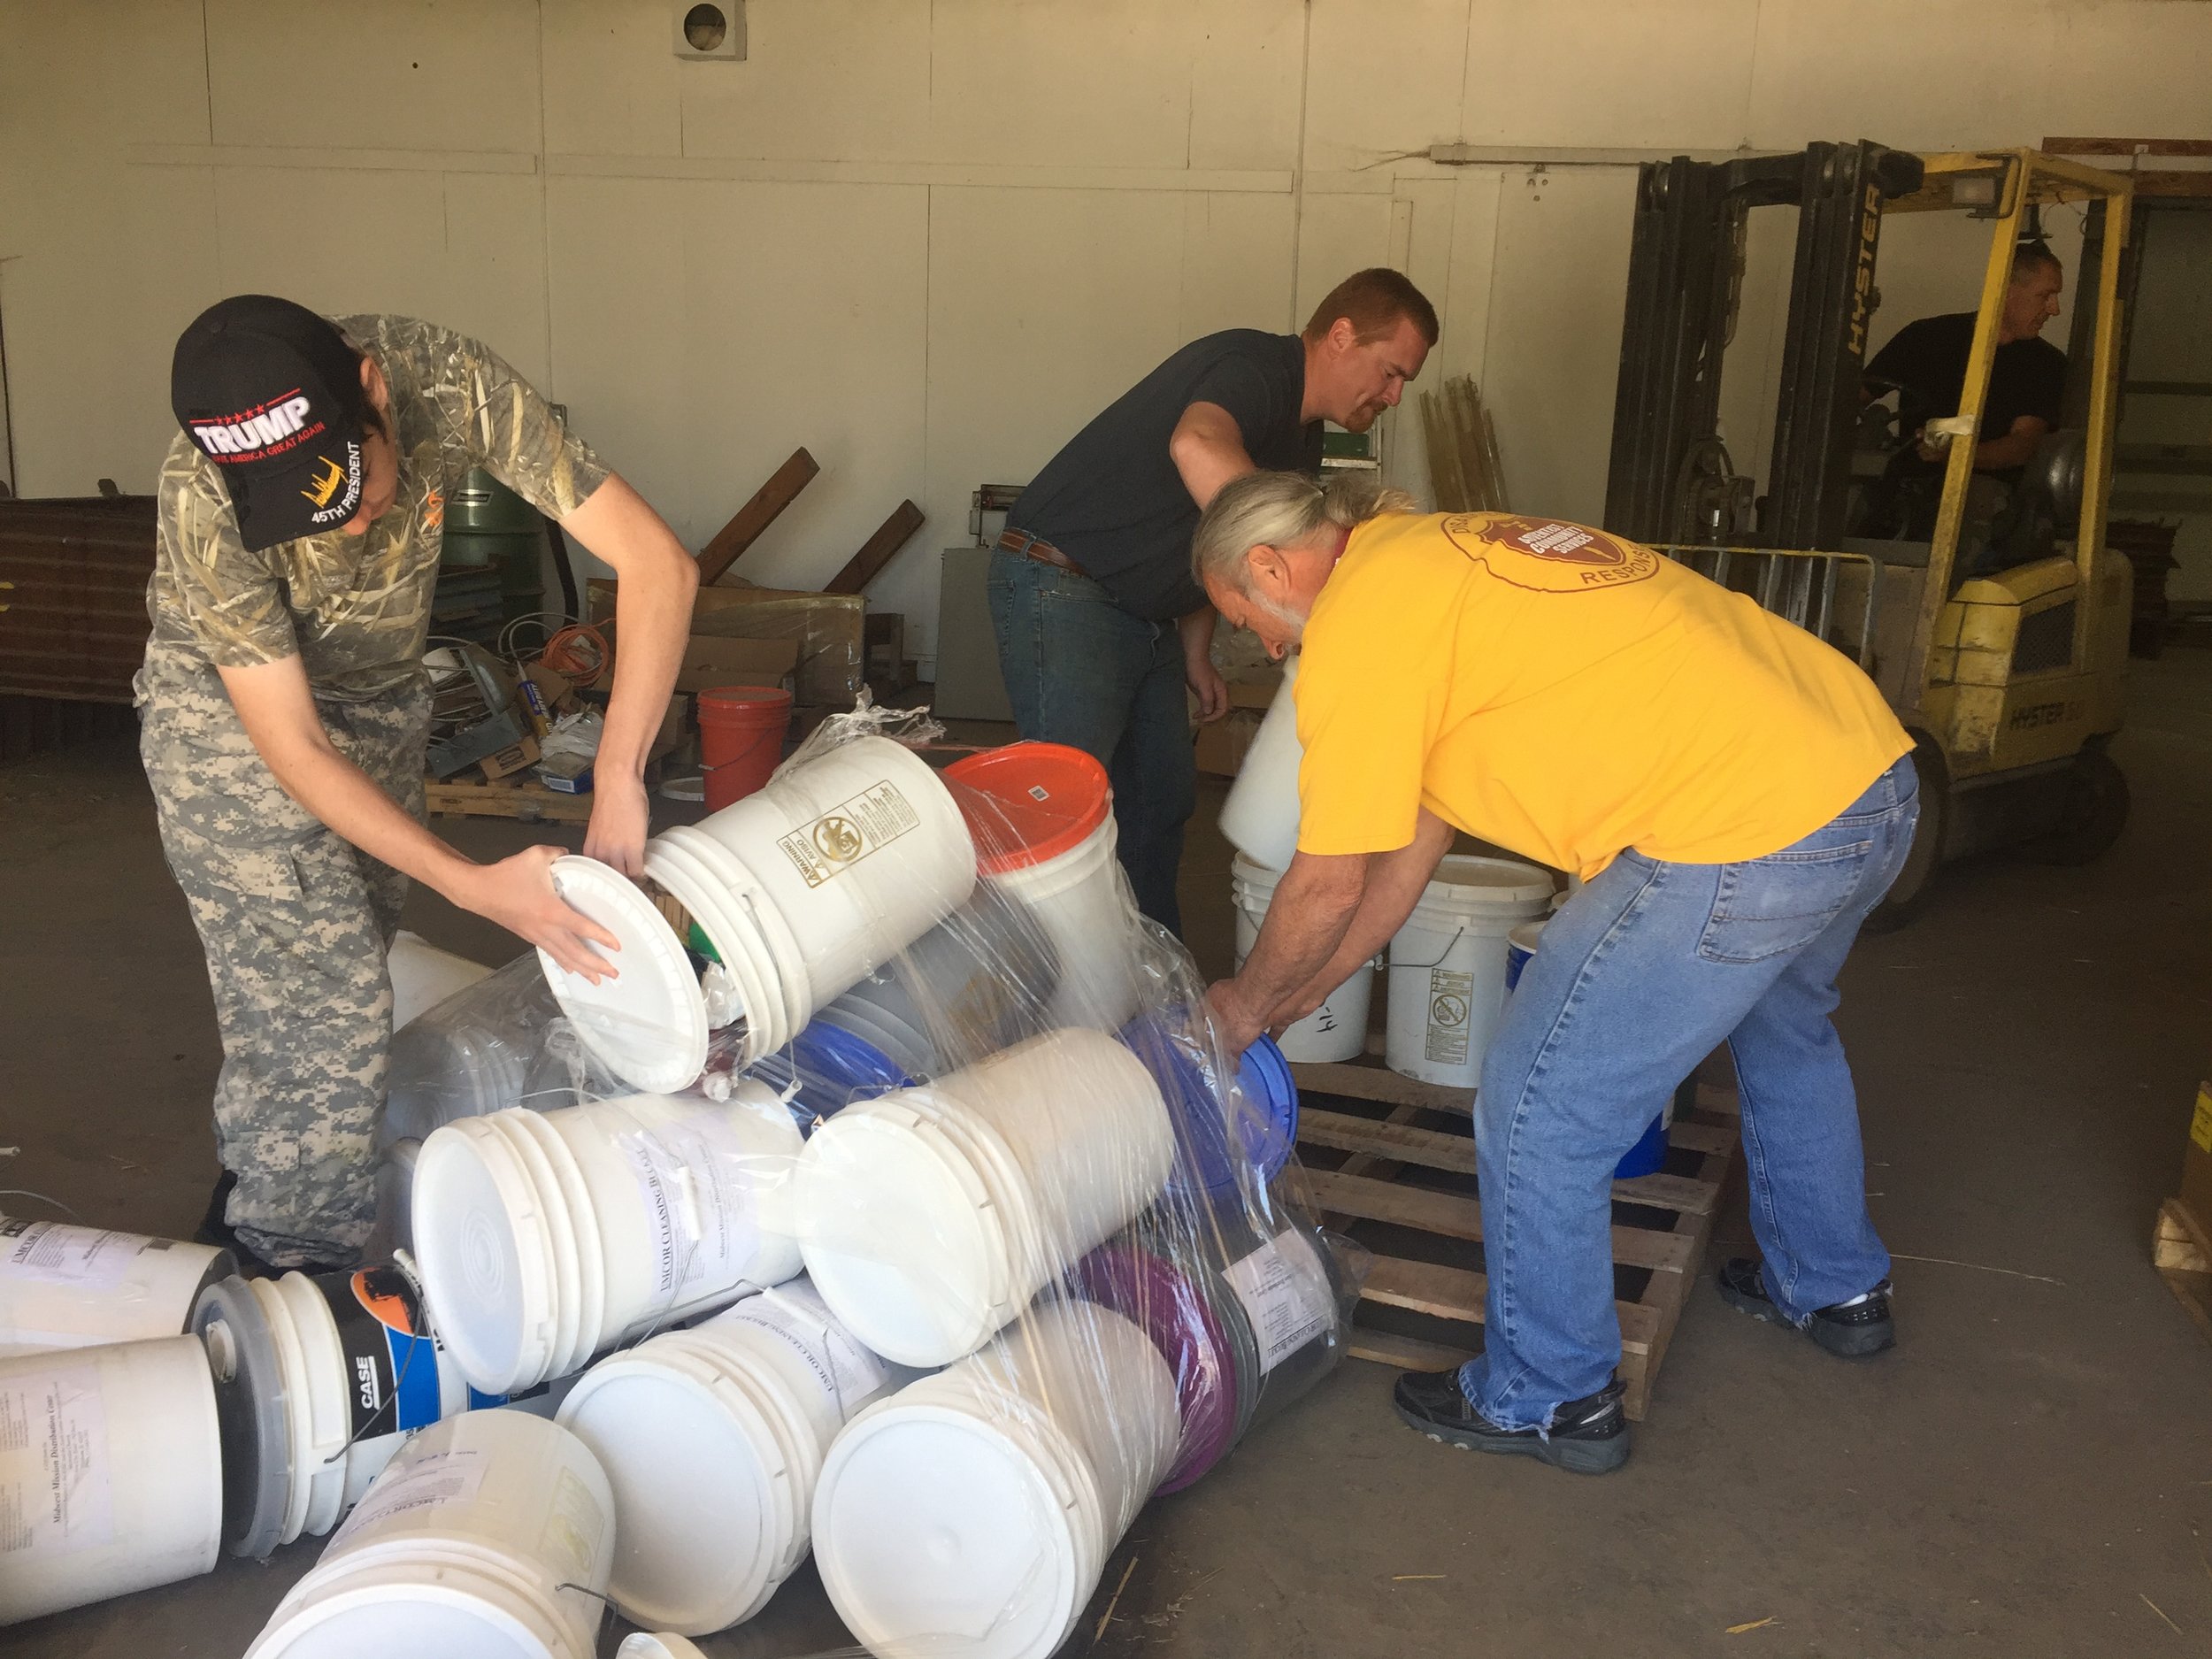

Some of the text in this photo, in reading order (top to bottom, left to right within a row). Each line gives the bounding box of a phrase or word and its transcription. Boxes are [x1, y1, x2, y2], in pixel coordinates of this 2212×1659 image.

[1848, 182, 1880, 355] HYSTER
[194, 396, 311, 454] TRUMP
[230, 449, 266, 463] AMERICA
[267, 438, 297, 456] GREAT
[297, 421, 326, 443] AGAIN
[311, 504, 345, 524] 45TH
[341, 441, 360, 511] PRESIDENT
[1529, 526, 1583, 554] COMMUNITY
[1552, 533, 1594, 554] SERVICES
[782, 840, 811, 876] WARNING
[796, 839, 819, 860] AVISO
[653, 1188, 671, 1245] CLEANING
[660, 1247, 672, 1292] UMCOR
[356, 1356, 373, 1409] CASE
[806, 1355, 833, 1392] UMCOR
